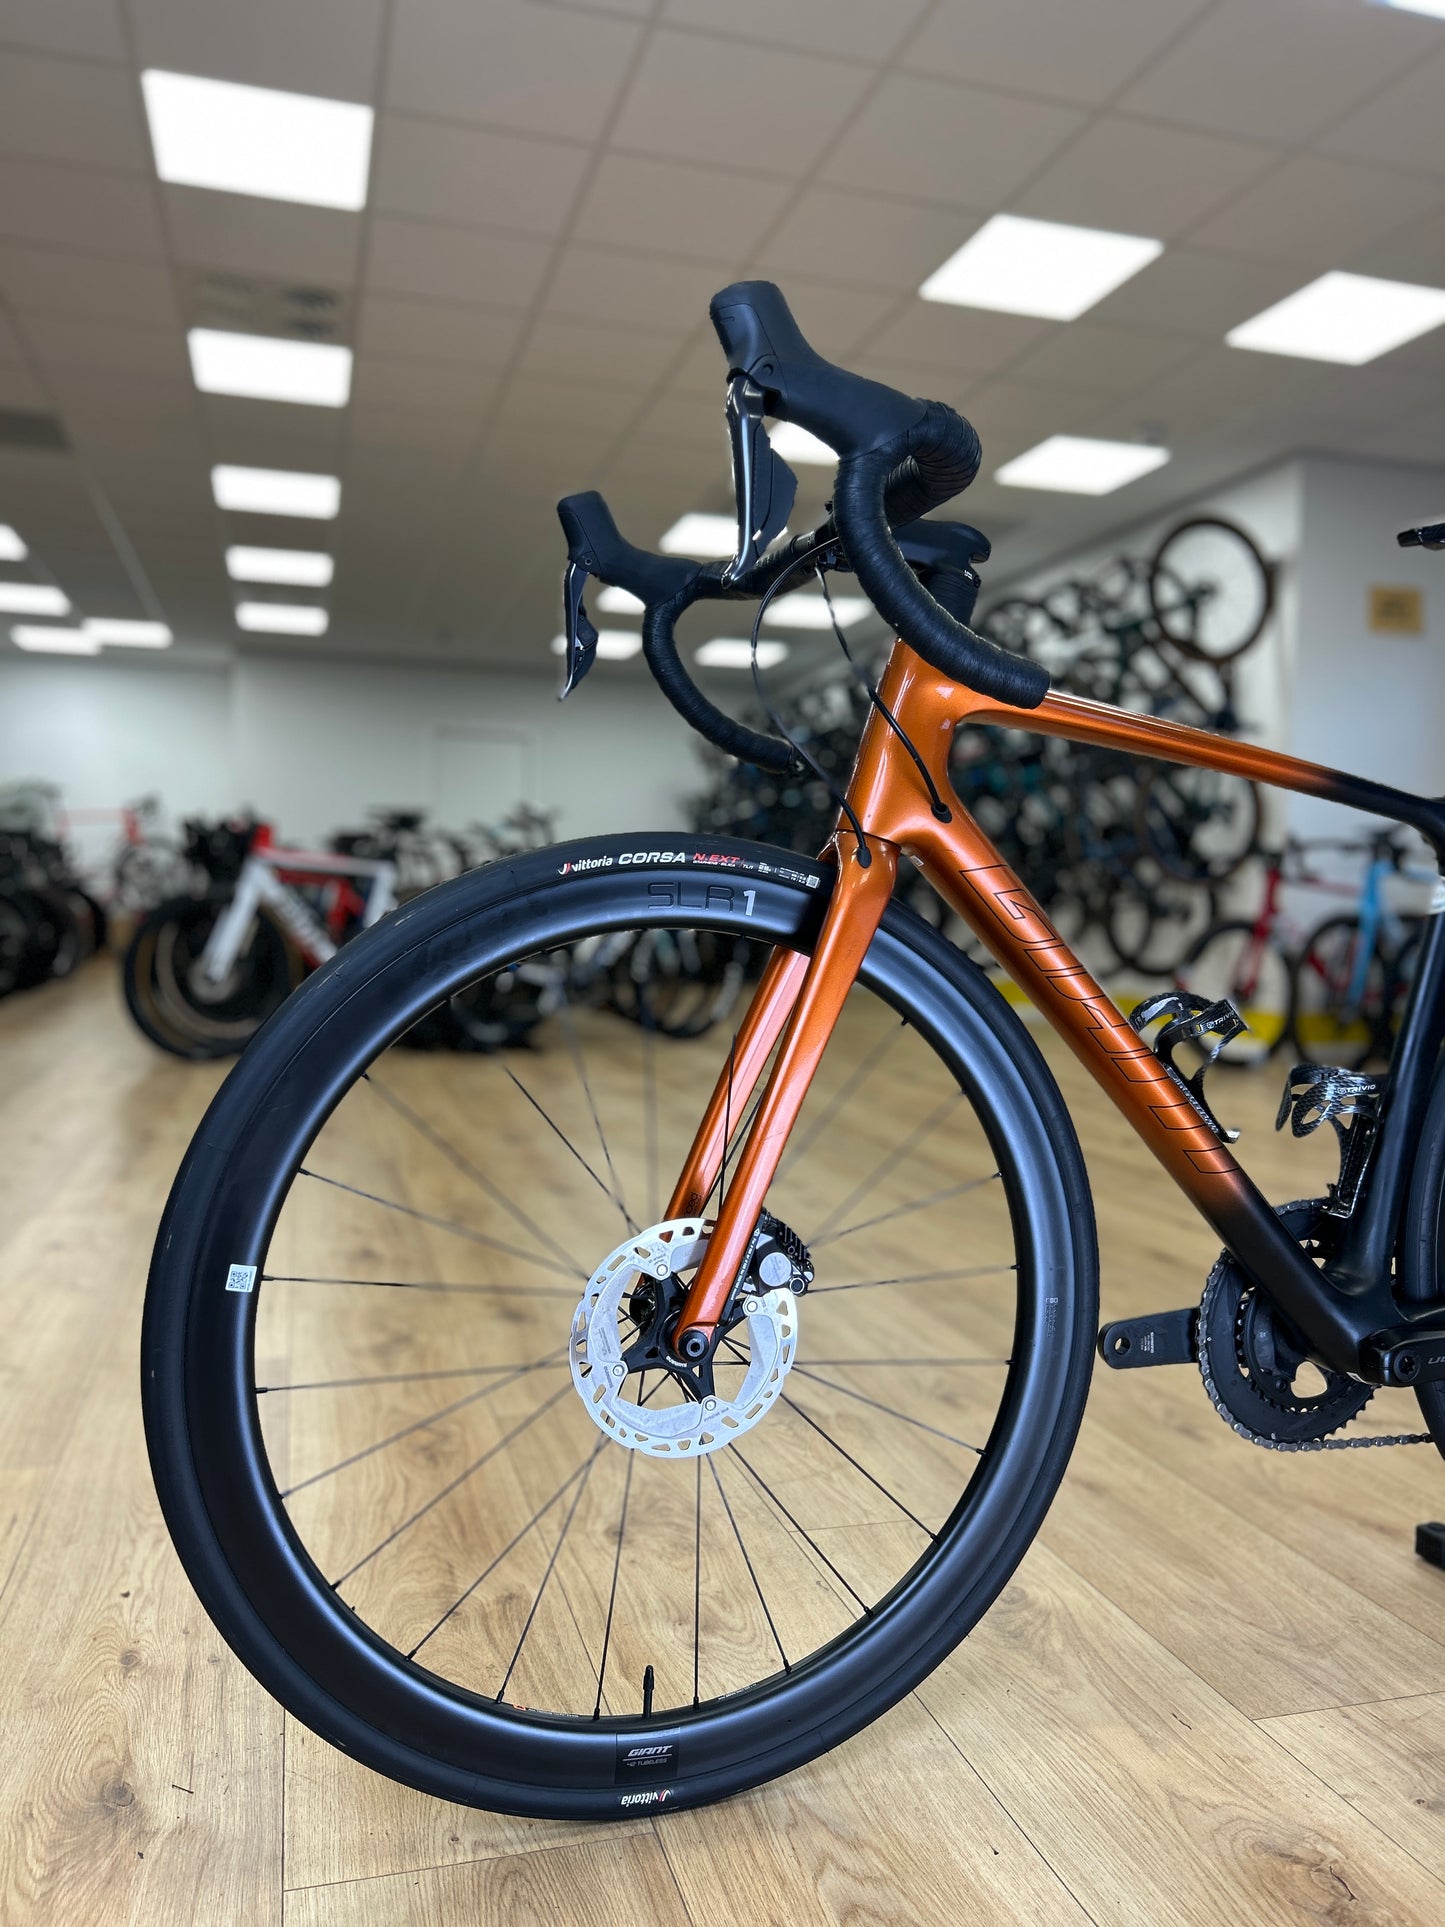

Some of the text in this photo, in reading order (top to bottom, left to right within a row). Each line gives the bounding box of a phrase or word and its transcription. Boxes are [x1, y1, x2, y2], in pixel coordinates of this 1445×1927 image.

[571, 856, 614, 872] vittoria
[618, 852, 686, 865] CORSA
[693, 853, 740, 864] N.EXT
[1214, 1009, 1236, 1025] TRIVIO
[1346, 1084, 1376, 1093] TRIVIO
[627, 1745, 673, 1757] GIANT
[637, 1758, 668, 1767] TUBELESS
[620, 1791, 659, 1808] vittoria
